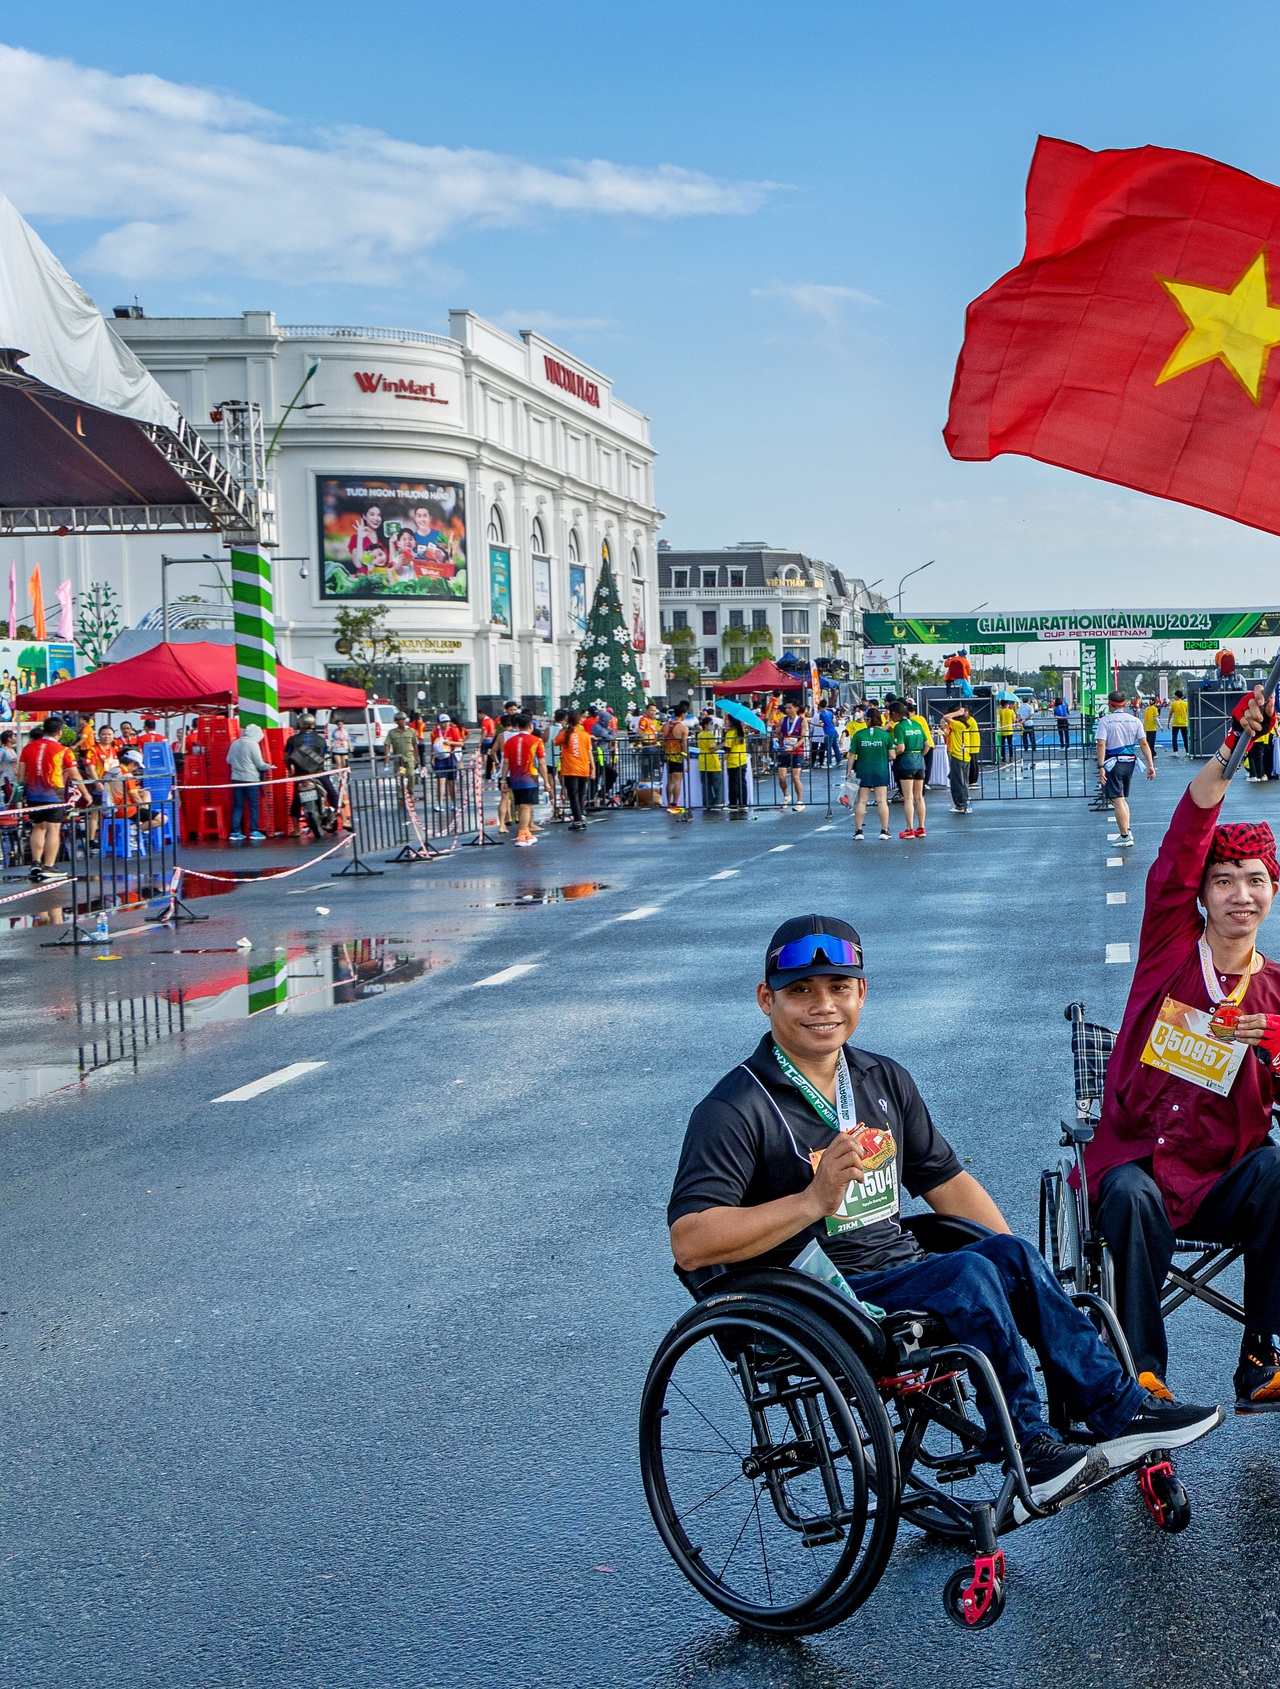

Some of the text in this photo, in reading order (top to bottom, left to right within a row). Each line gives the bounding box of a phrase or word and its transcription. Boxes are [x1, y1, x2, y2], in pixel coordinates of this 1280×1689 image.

[354, 372, 436, 396] WinMart
[543, 355, 600, 408] VINCOM PLAZA
[369, 488, 395, 498] NGON
[979, 611, 1210, 632] GIẢI MARATHON CÀ MAU 2024
[1069, 629, 1147, 637] PETROVIETNAM
[970, 645, 1004, 654] 03:40:29
[1185, 641, 1218, 649] 02:40:29
[1081, 643, 1097, 691] START
[838, 1072, 849, 1109] MARATHON
[845, 1166, 893, 1204] 21504
[837, 1220, 858, 1233] 21KM
